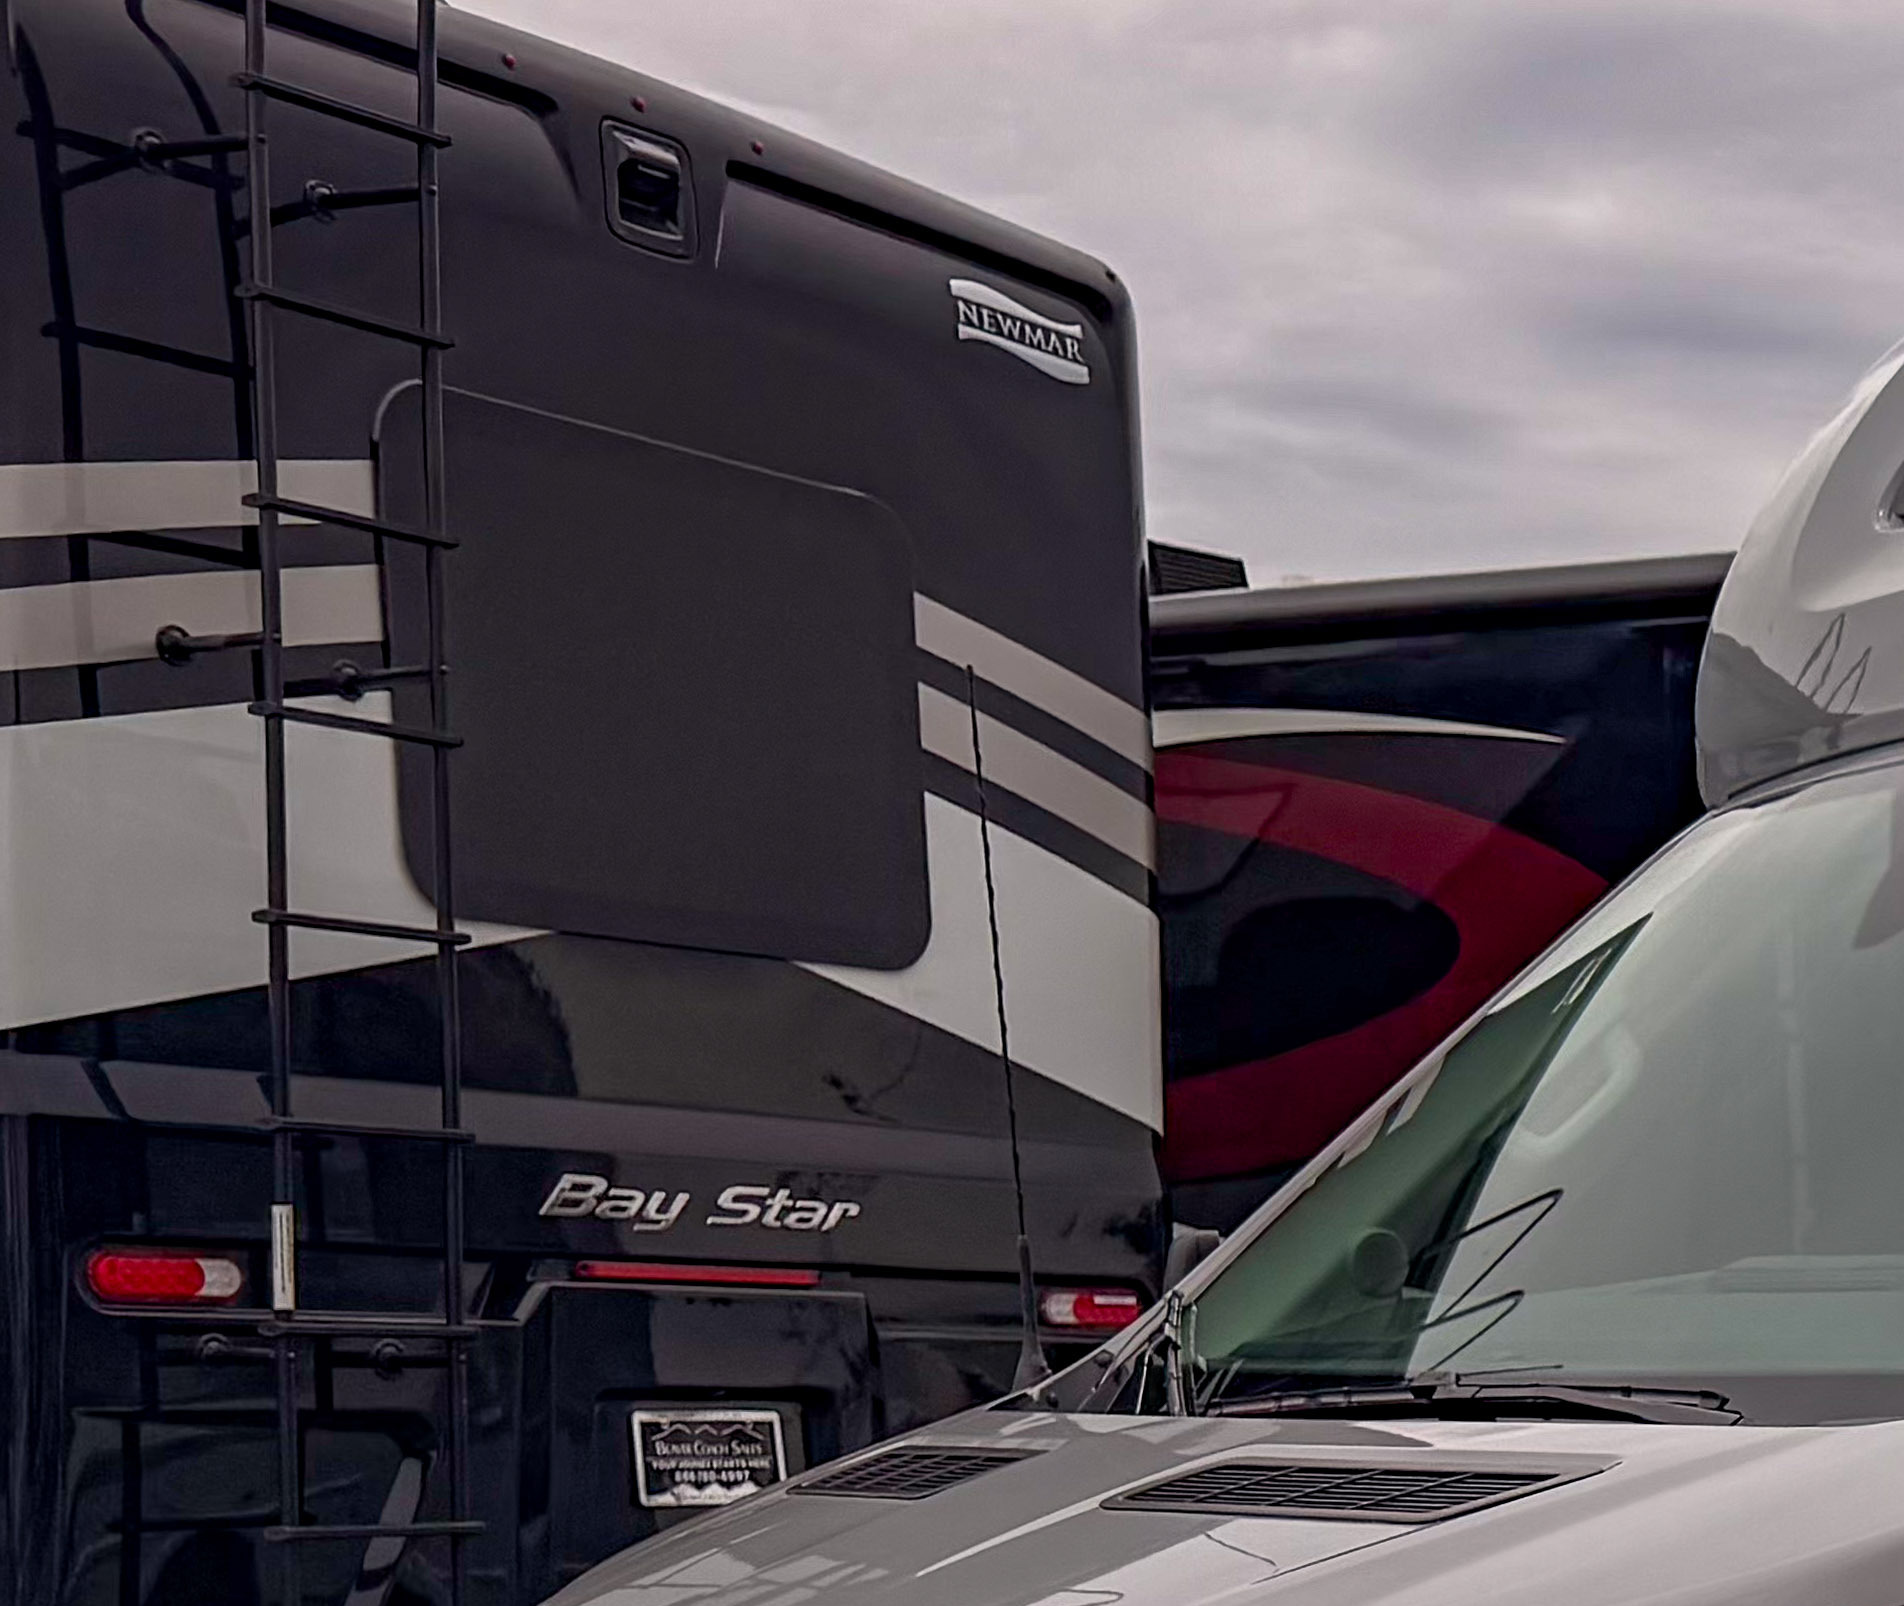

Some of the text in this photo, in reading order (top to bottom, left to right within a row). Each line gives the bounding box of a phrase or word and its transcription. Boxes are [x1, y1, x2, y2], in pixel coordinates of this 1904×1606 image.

[957, 300, 1085, 363] NEWMAR
[538, 1173, 861, 1232] Bay Star
